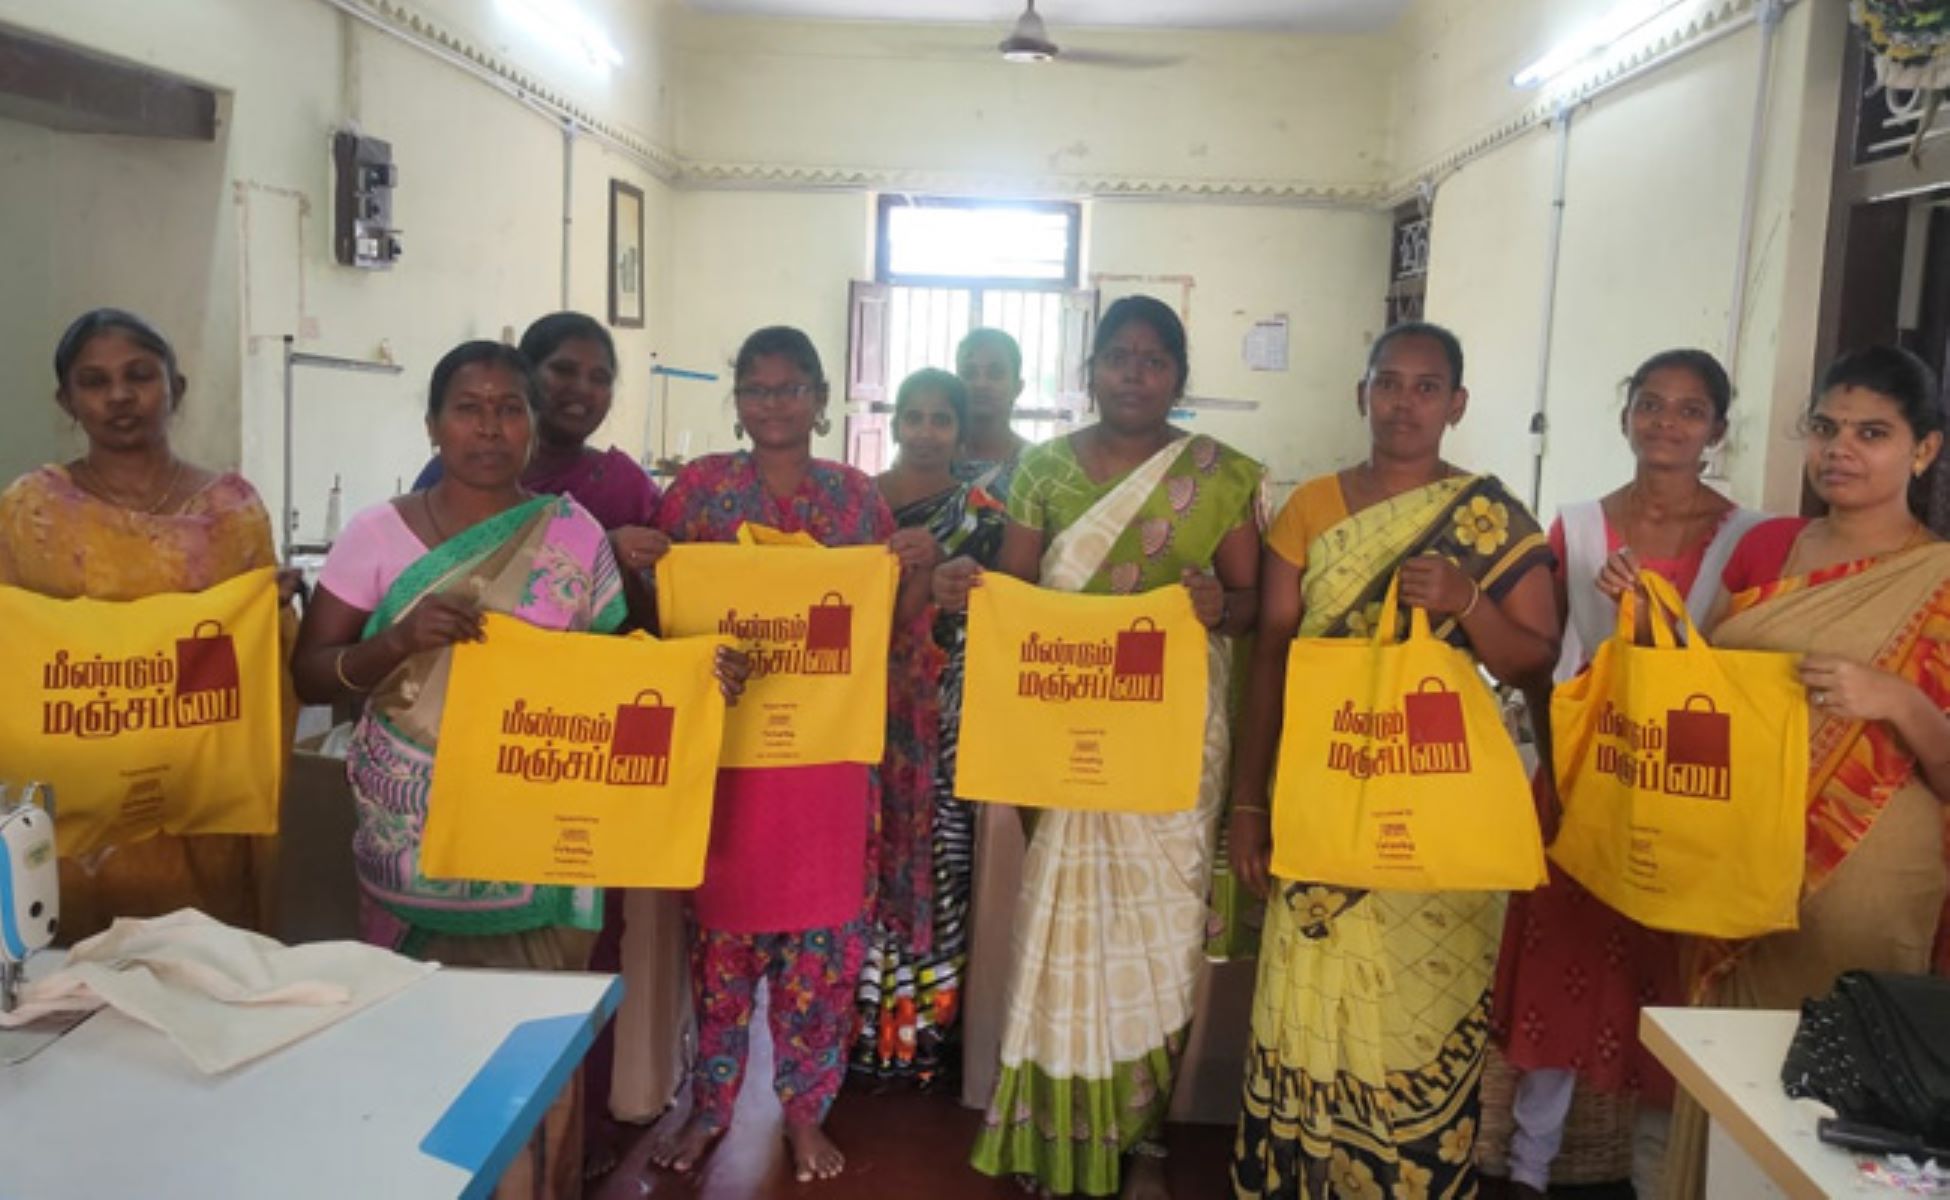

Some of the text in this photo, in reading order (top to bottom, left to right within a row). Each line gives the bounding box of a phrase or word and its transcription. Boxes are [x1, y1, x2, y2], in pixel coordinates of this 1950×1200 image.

[717, 609, 807, 643] மீண்டும்
[1020, 632, 1113, 667] மீண்டும்
[44, 650, 174, 690] மீண்டும்
[1017, 667, 1163, 702] மஞ்சப்பை
[42, 689, 240, 738] மஞ்சப்பை
[502, 699, 612, 744] மீண்டும்
[496, 740, 668, 786] மஞ்சப்பை
